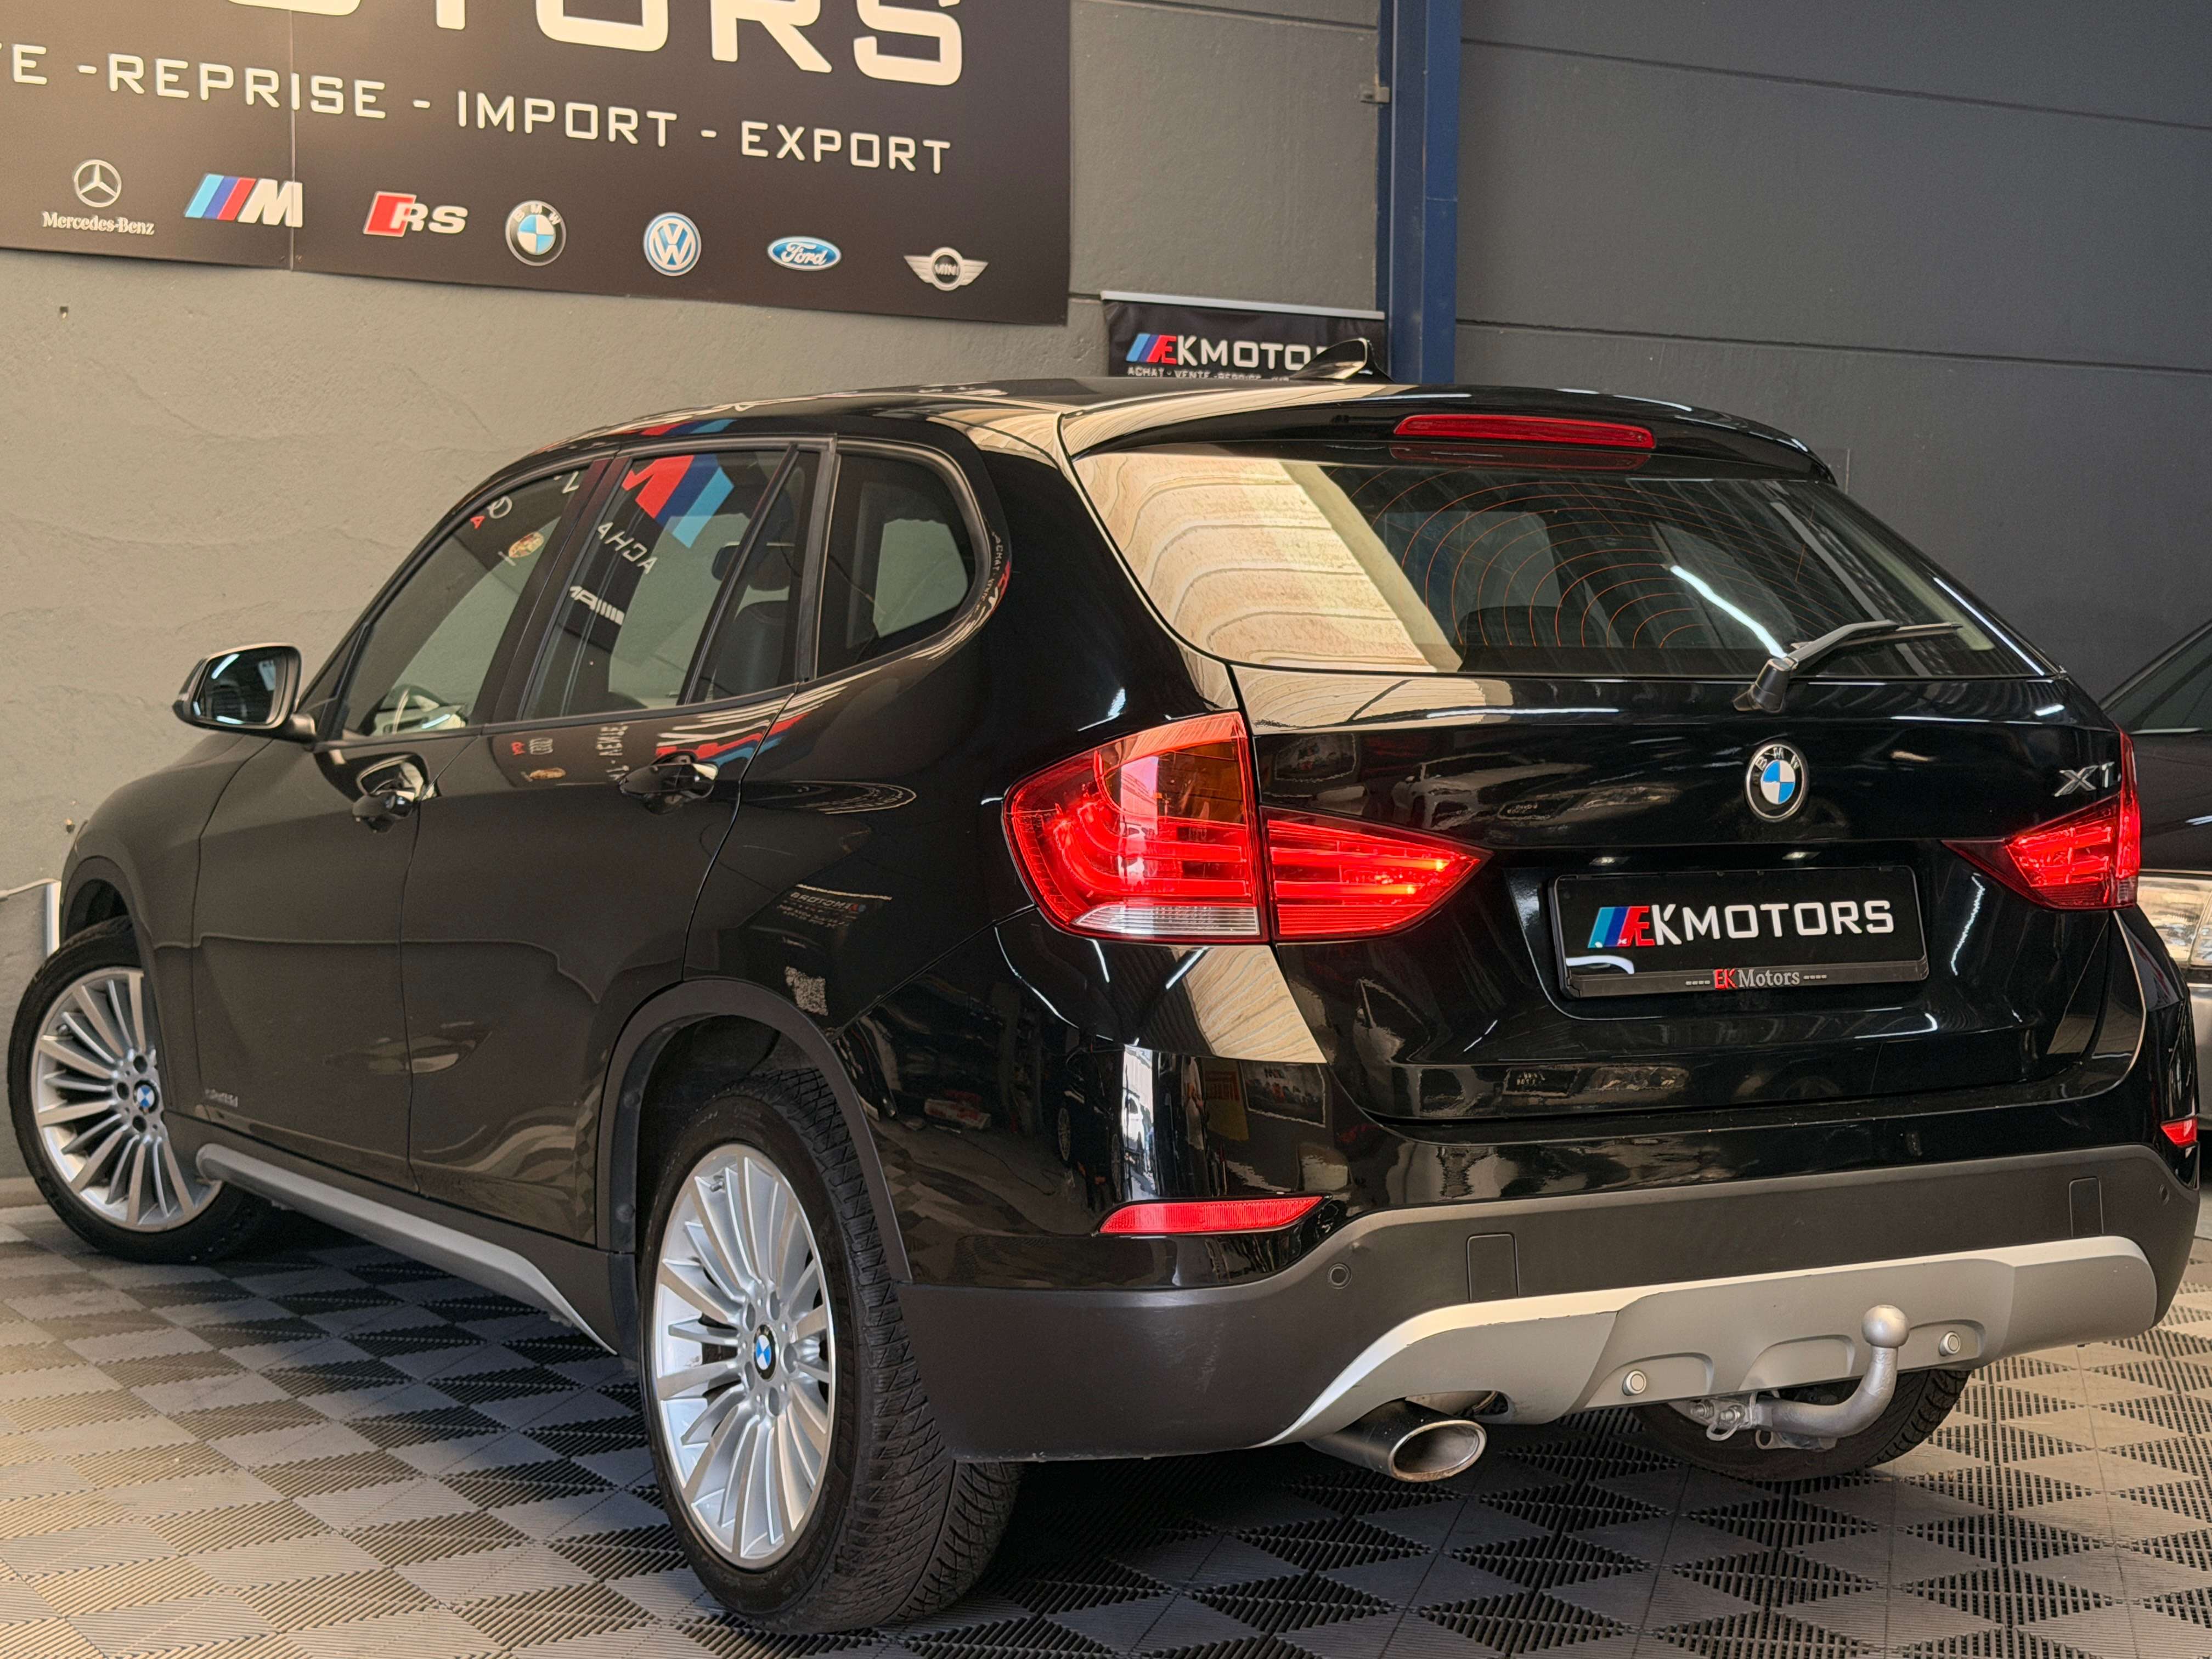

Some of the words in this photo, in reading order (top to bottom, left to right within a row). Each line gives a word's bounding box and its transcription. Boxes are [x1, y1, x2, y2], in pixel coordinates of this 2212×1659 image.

[458, 90, 678, 147] IMPORT
[741, 121, 951, 174] EXPORT
[42, 211, 155, 236] Mercedes-Benz
[391, 202, 468, 235] RS
[780, 240, 828, 267] Ford
[1146, 334, 1328, 371] EKMOTO
[1754, 746, 1801, 771] BMW
[2053, 761, 2115, 798] X1
[1618, 900, 1894, 947] EKMOTORS
[1714, 968, 1737, 989] EK
[1738, 969, 1801, 987] Motors
